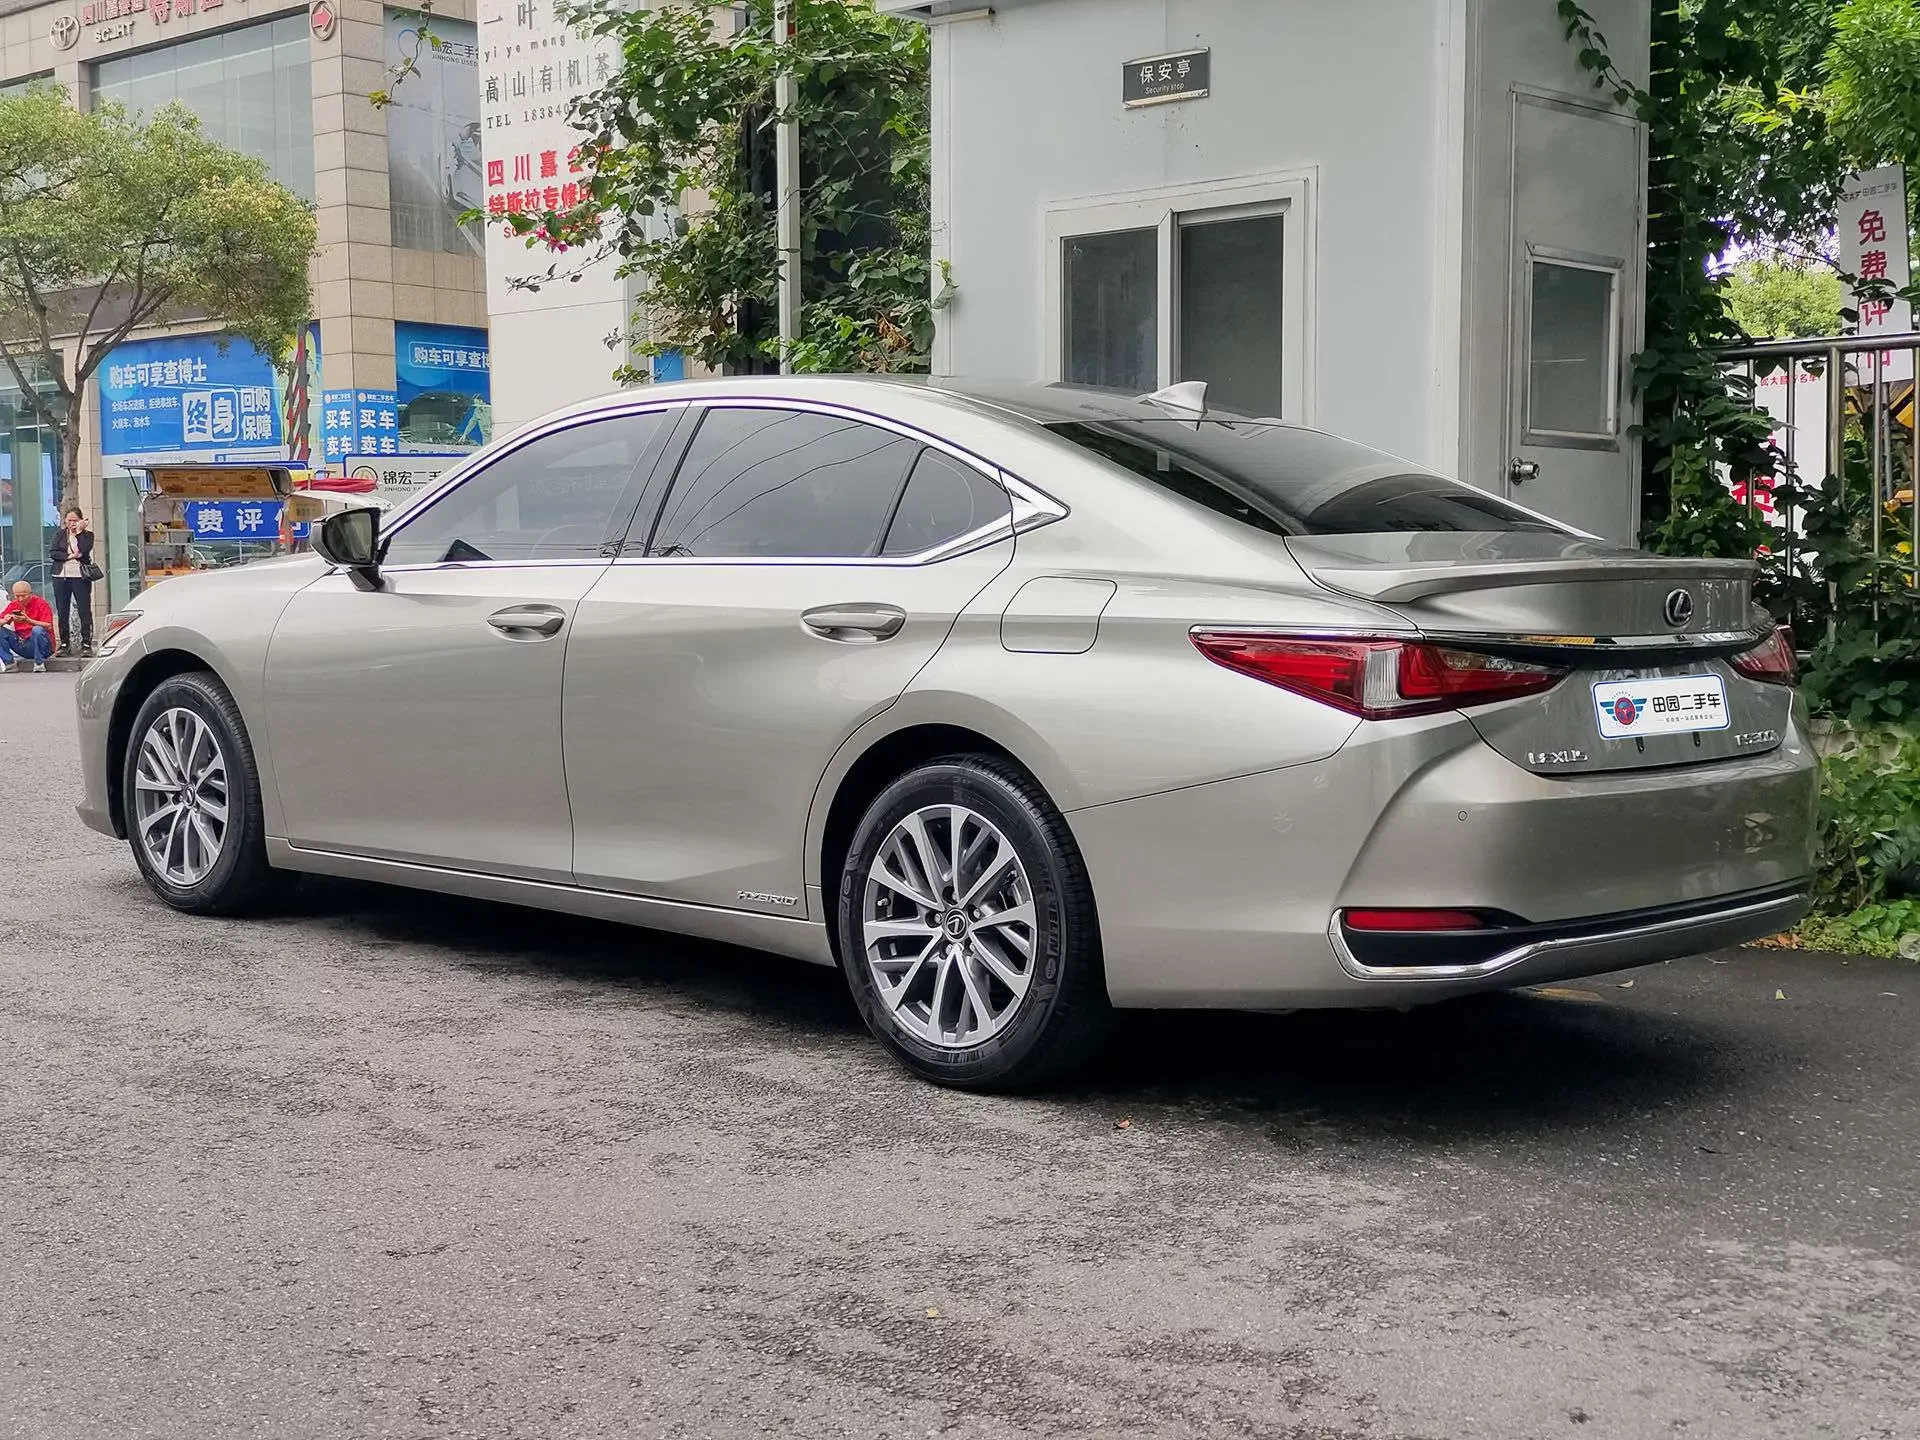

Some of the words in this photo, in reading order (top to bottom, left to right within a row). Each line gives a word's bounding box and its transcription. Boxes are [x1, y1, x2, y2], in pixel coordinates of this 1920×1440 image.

[1139, 59, 1191, 84] 保安亭
[1145, 85, 1170, 95] Security
[487, 114, 511, 129] TEL
[109, 356, 207, 389] 购车可享查博士
[240, 386, 270, 413] 回购
[186, 396, 235, 434] 终身
[325, 408, 352, 430] 买车
[360, 408, 395, 430] 买车
[241, 414, 272, 441] 保障
[327, 434, 353, 456] 卖车
[361, 434, 397, 454] 卖车
[1652, 692, 1721, 713] 田园二手车
[737, 890, 799, 906] HYBRID
